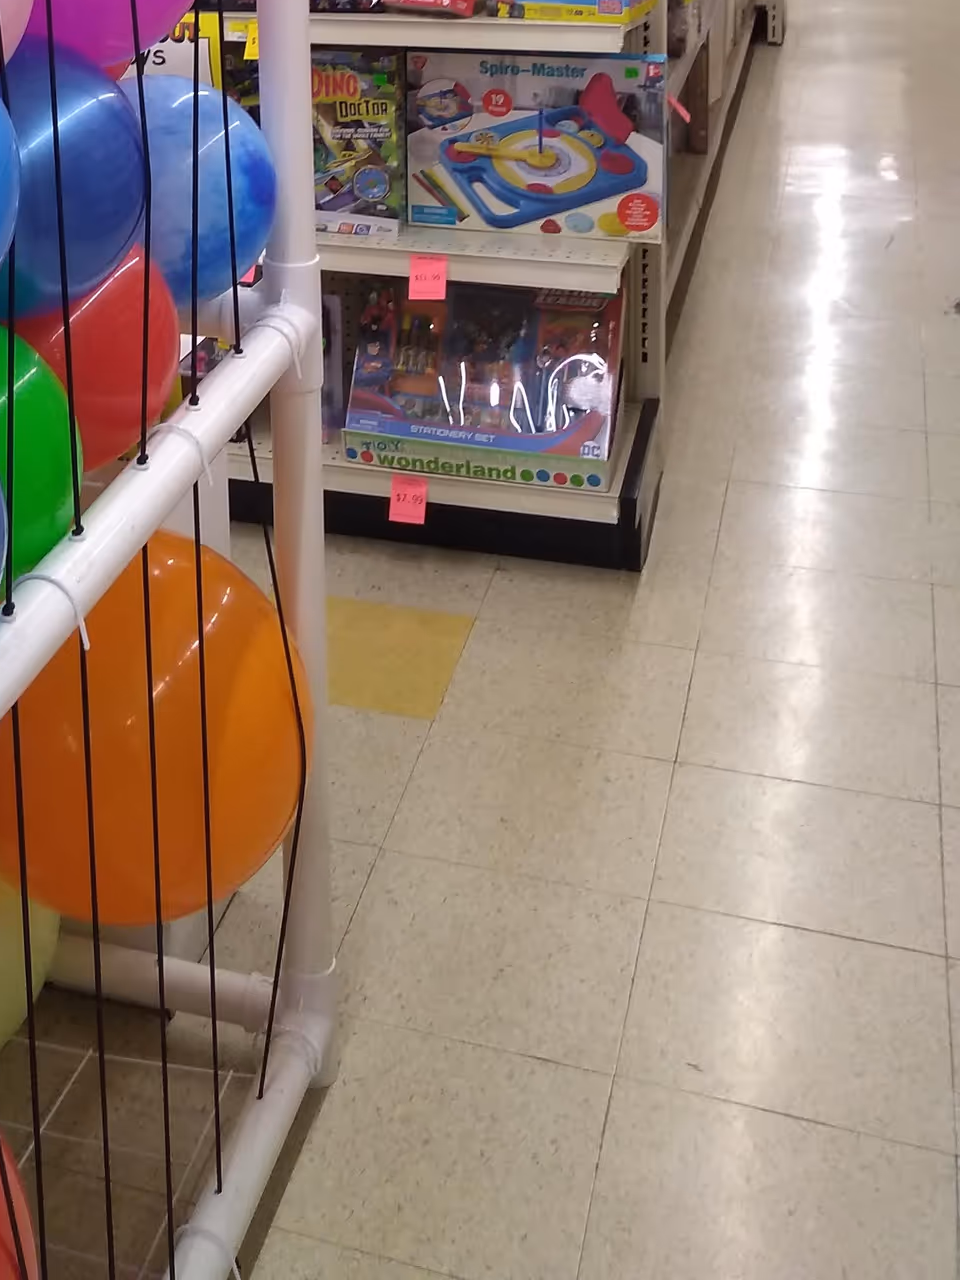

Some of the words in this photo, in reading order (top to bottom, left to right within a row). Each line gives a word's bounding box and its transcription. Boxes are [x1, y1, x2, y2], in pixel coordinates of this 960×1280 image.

[479, 60, 588, 79] Spiro-Master
[312, 66, 359, 98] DINO
[490, 94, 505, 106] 19
[410, 424, 473, 441] STATIONERY
[474, 431, 496, 444] SET
[376, 451, 517, 481] wonderland
[396, 493, 423, 505] $7.99
